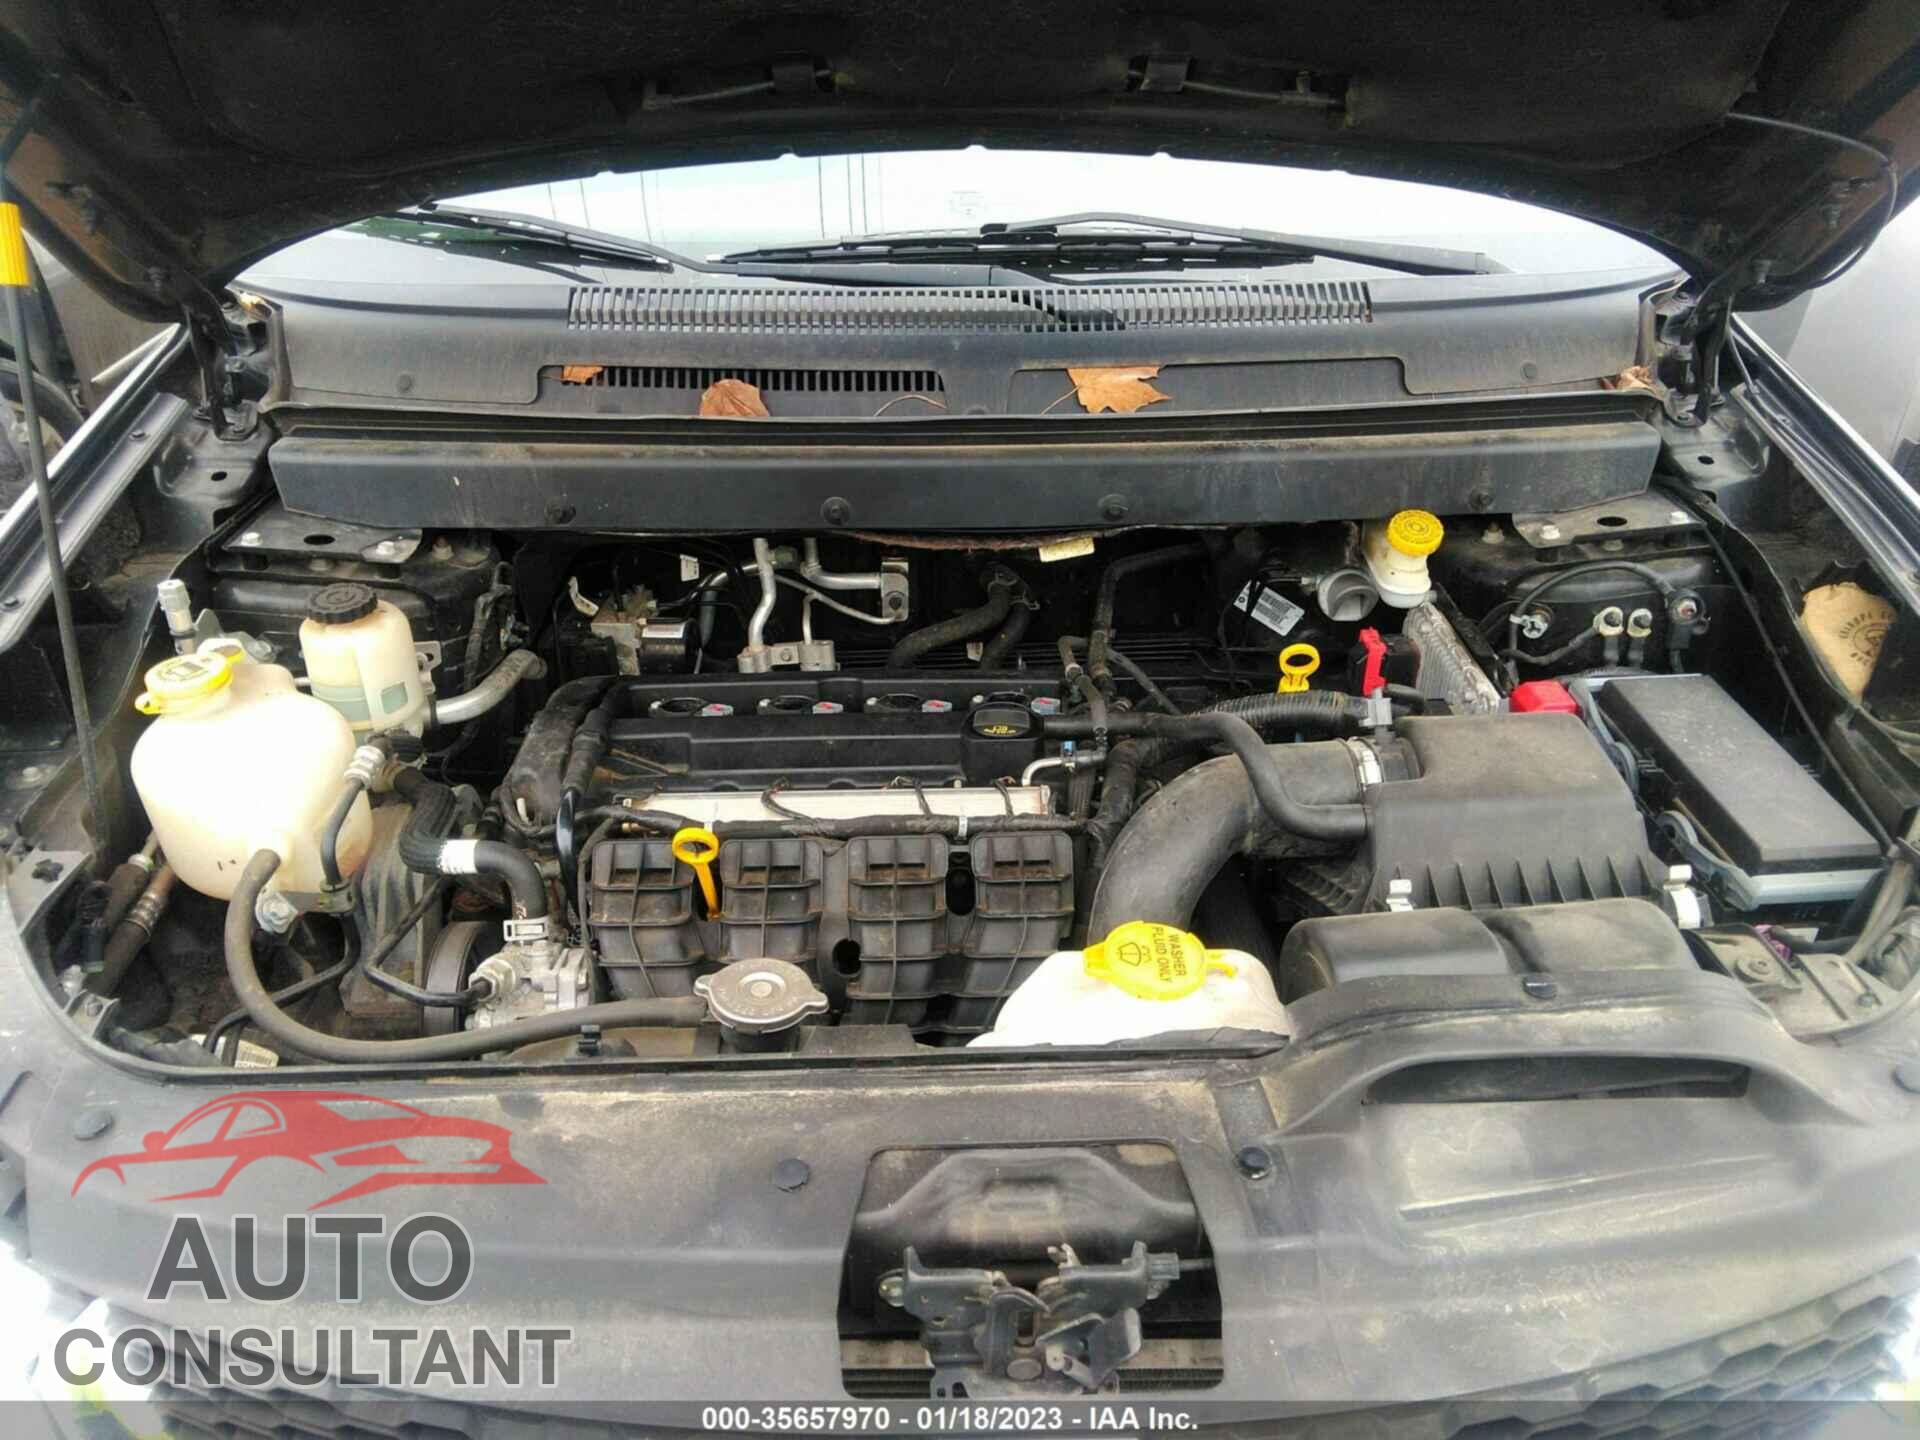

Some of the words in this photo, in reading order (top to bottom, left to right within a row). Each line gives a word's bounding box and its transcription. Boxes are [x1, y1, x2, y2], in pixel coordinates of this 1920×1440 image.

[1153, 927, 1168, 954] FLUID
[1169, 935, 1187, 976] WASHER
[1157, 957, 1171, 982] ONLY
